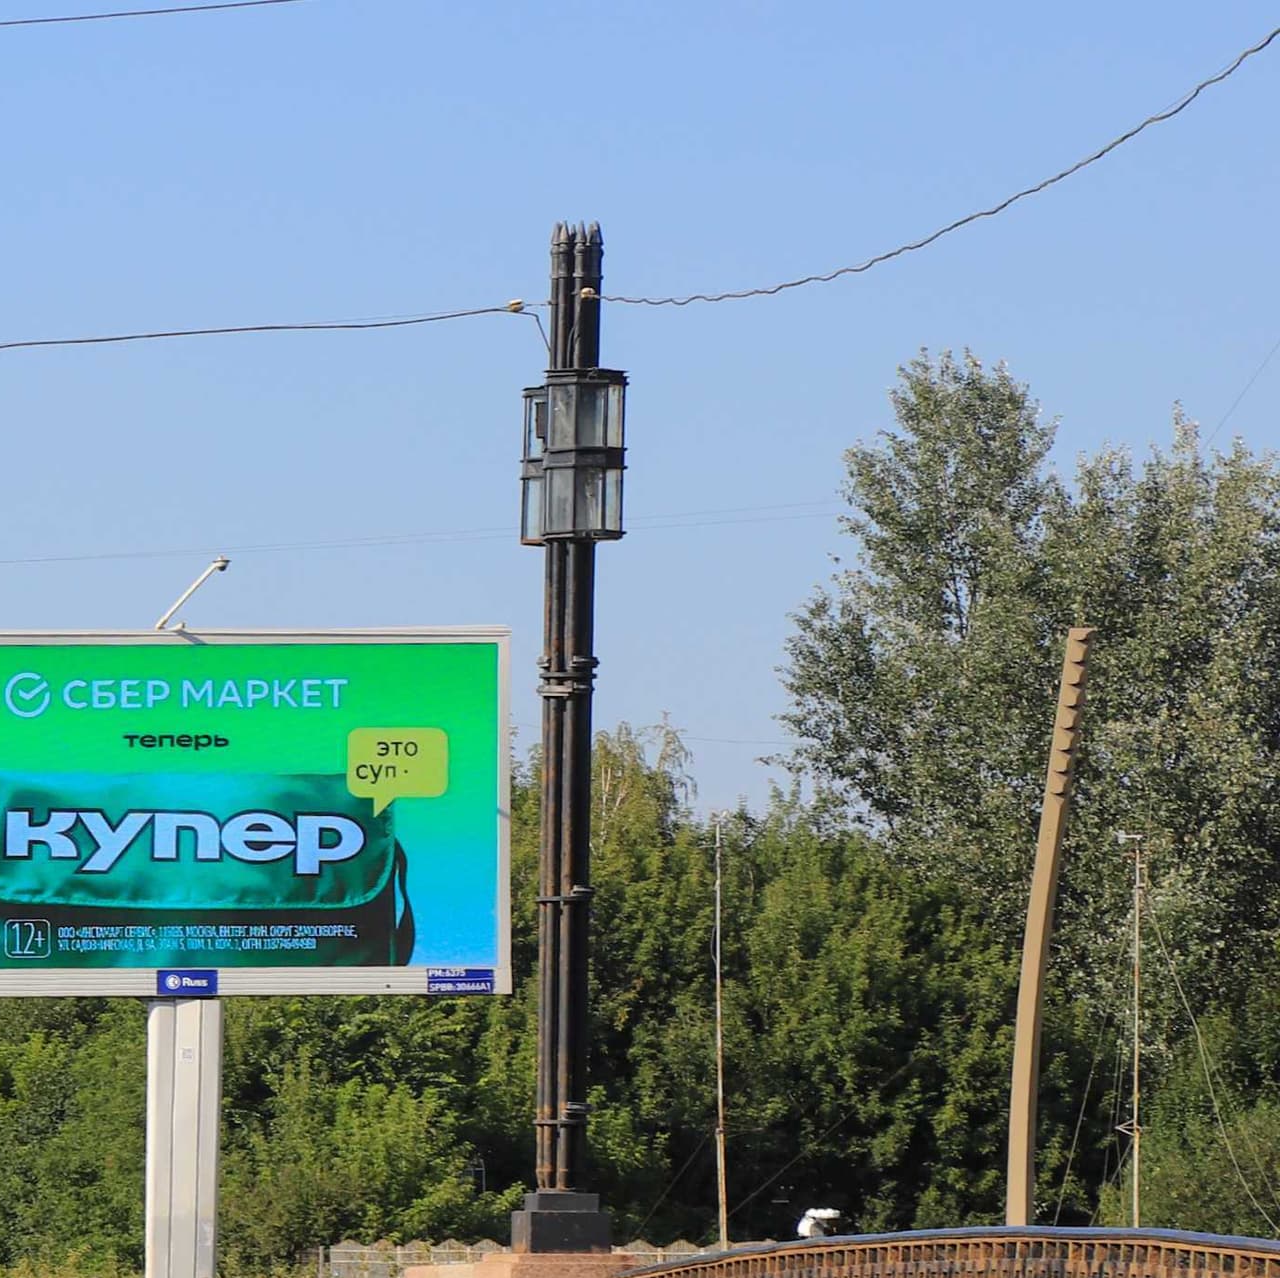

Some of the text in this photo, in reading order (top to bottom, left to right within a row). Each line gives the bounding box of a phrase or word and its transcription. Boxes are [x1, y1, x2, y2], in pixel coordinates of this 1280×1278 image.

[62, 678, 349, 709] СБЕР МАРКЕТ
[122, 733, 230, 751] теперь
[376, 741, 419, 757] это
[4, 809, 366, 876] купер
[10, 922, 46, 955] 12+
[181, 976, 209, 987] Russ
